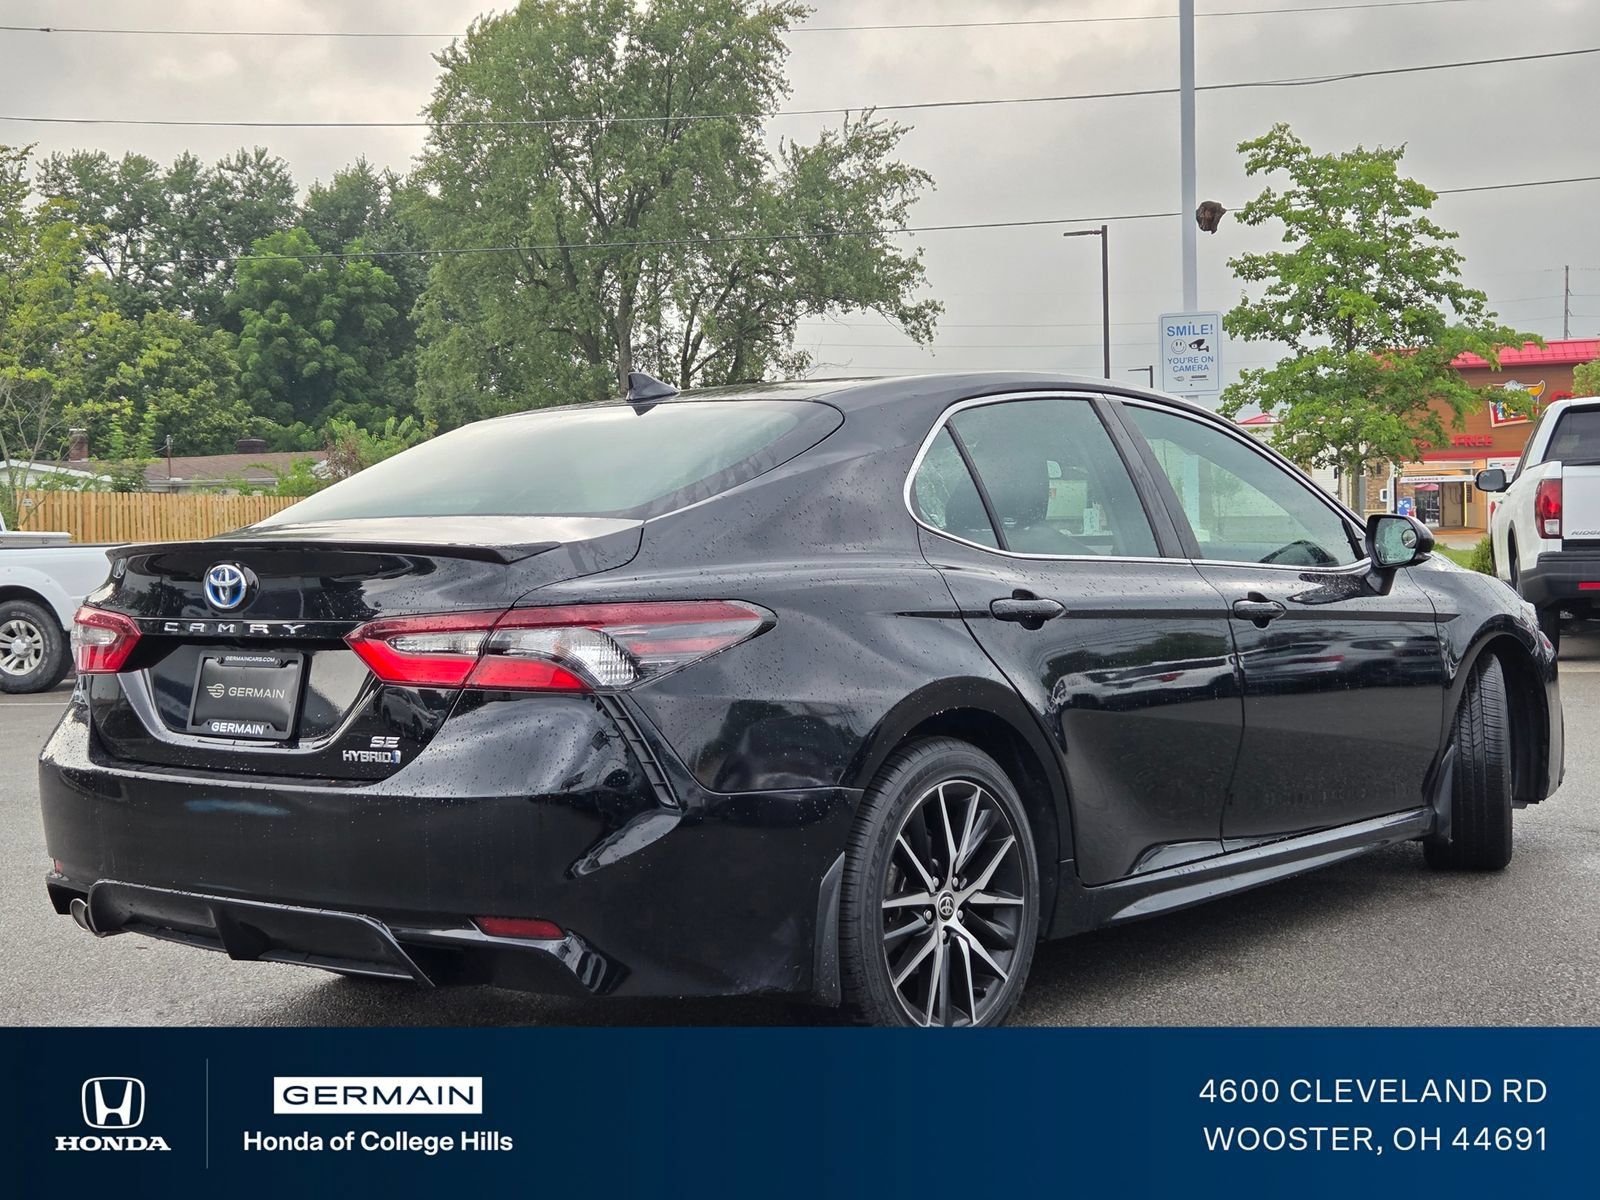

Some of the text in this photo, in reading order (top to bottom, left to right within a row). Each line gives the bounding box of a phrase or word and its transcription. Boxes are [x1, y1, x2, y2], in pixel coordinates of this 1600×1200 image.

[1167, 324, 1213, 337] SMILE!
[1168, 355, 1214, 365] YOU'RE ON
[1173, 364, 1209, 373] CAMERA
[1454, 433, 1494, 448] FREE
[164, 622, 306, 634] CAMRY
[225, 655, 276, 663] GERMAINCARS.COM
[228, 687, 285, 699] GERMAIN
[211, 722, 265, 735] GERMAIN
[370, 736, 401, 748] SE
[342, 750, 392, 763] HYBRID
